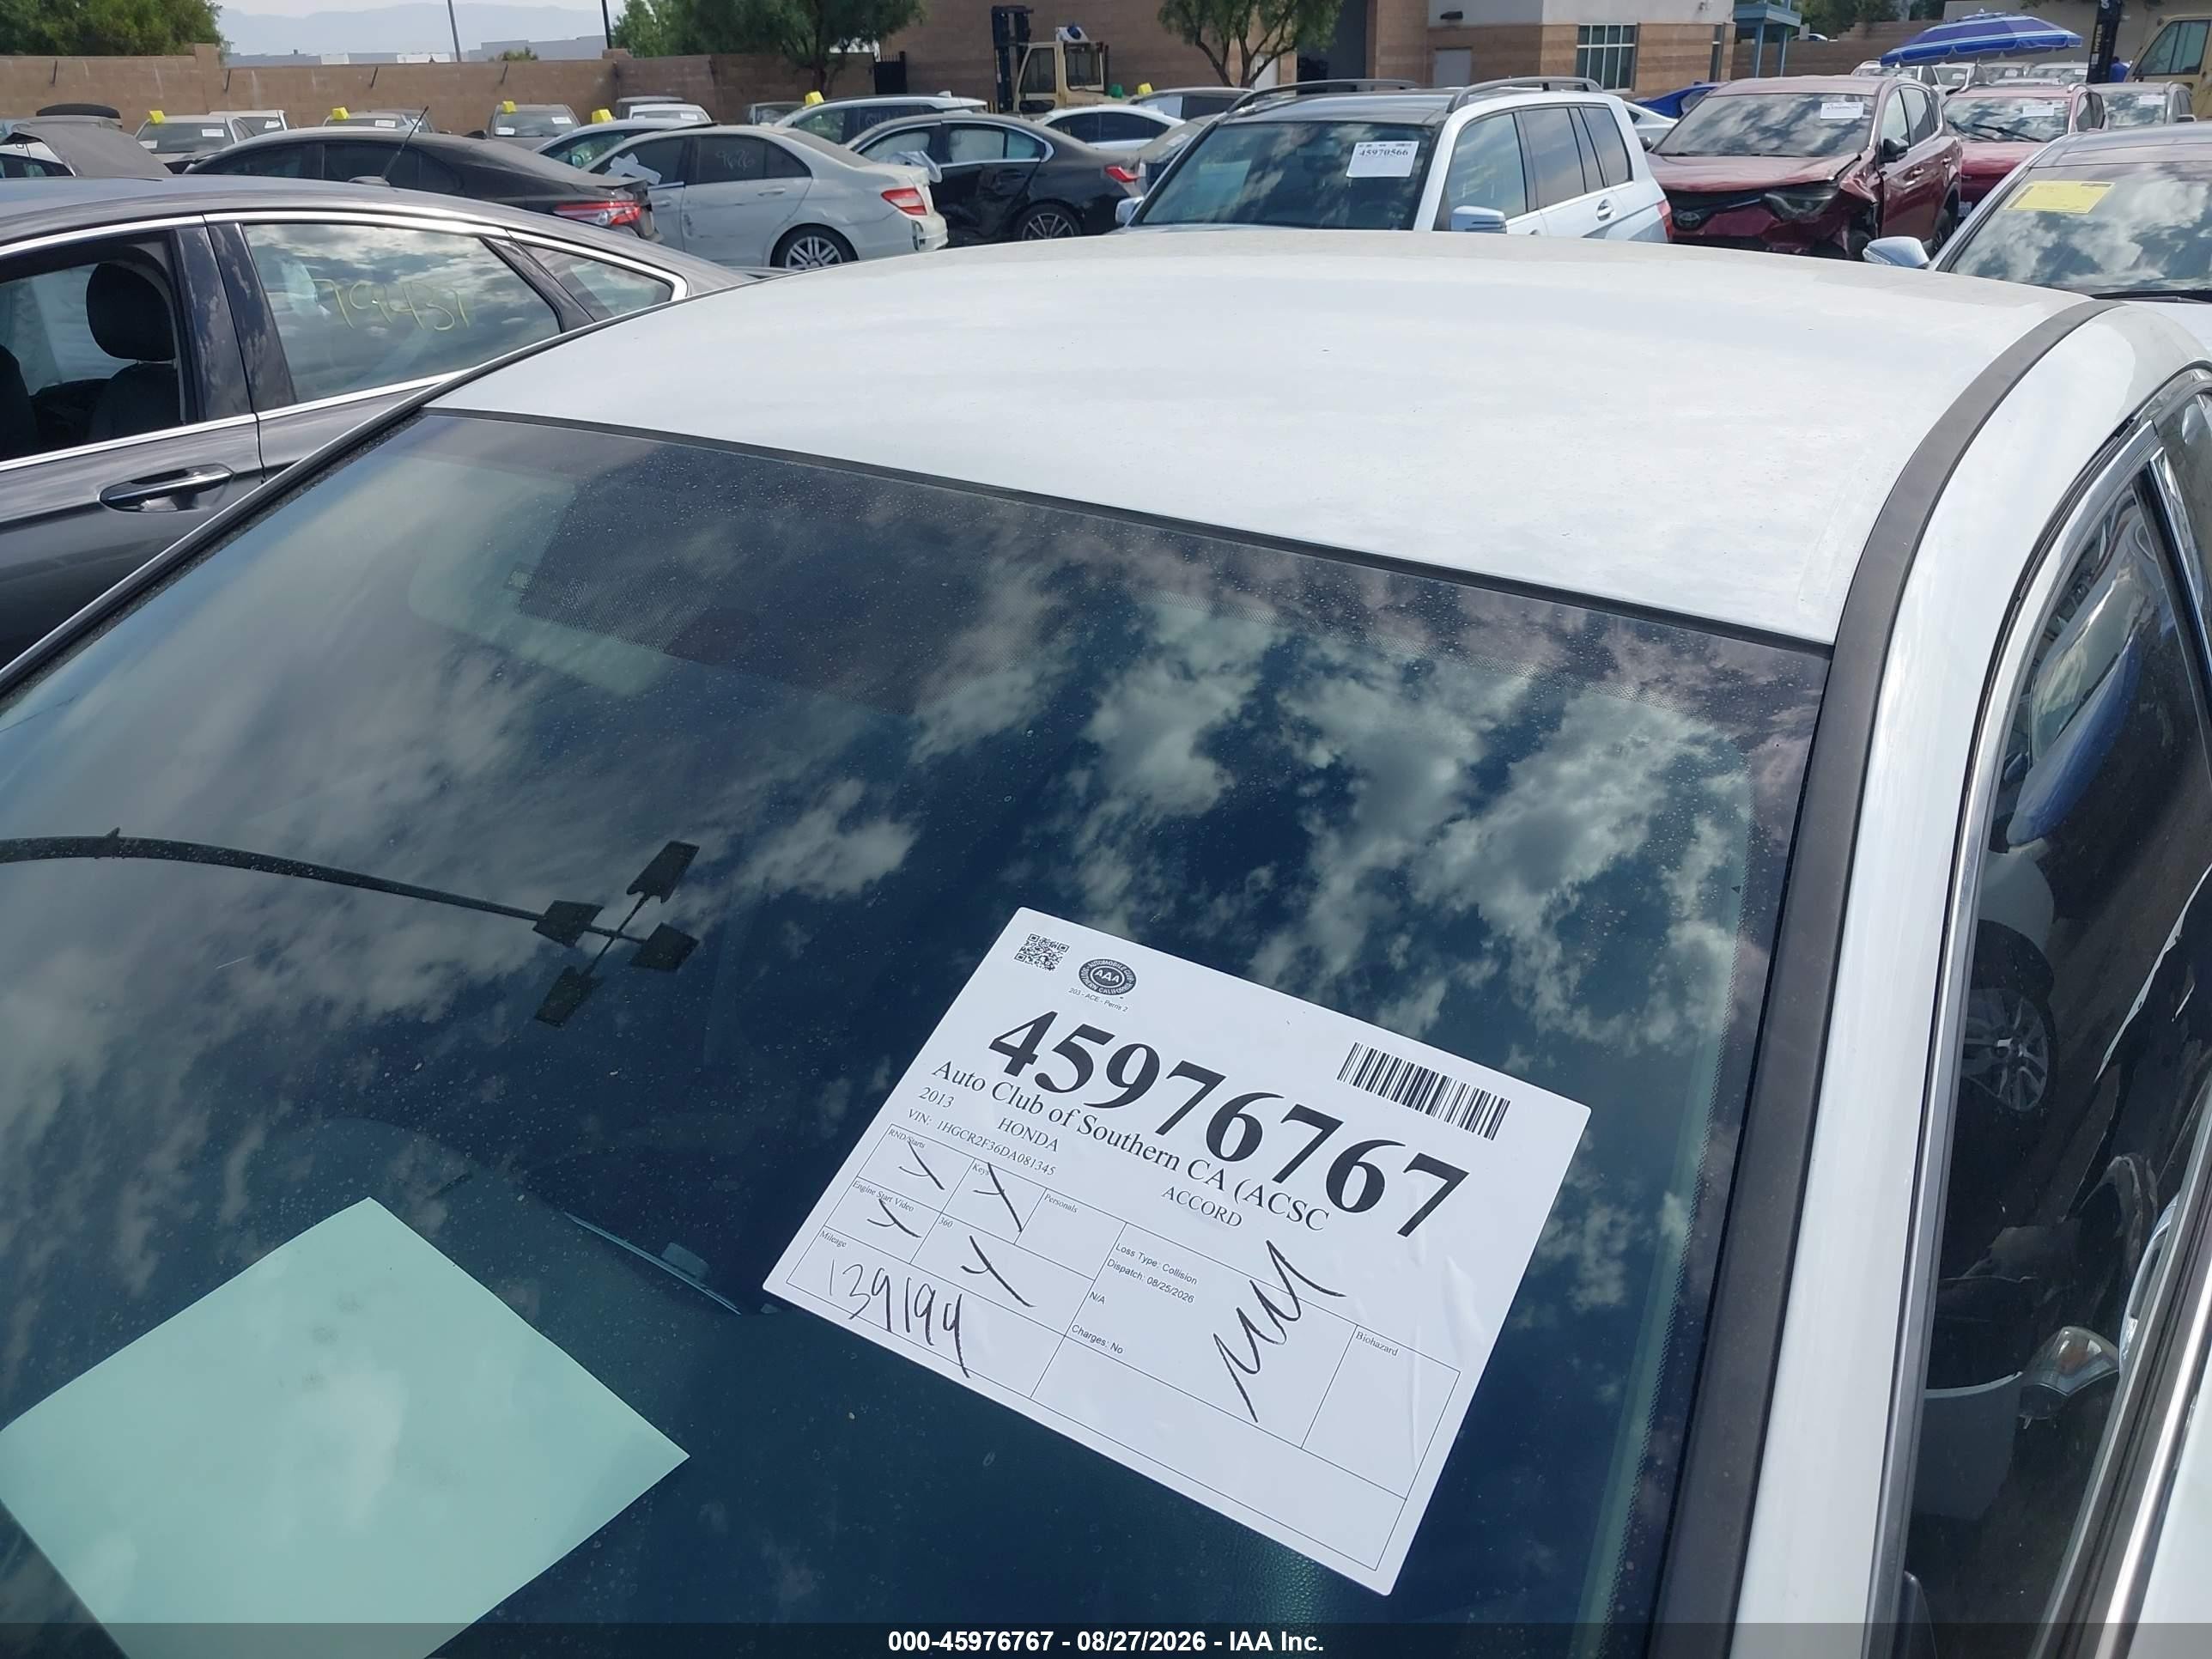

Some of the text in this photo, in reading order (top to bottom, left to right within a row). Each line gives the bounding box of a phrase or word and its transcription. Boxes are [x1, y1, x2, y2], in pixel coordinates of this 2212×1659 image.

[1094, 969, 1121, 983] AAA
[1068, 988, 1081, 996] 203
[1085, 993, 1101, 1002] ACE
[919, 1086, 955, 1109] 2013
[988, 1010, 1470, 1238] 45976767
[997, 1117, 1059, 1152] HONDA
[888, 1127, 926, 1149] RND/Starts
[908, 1109, 1057, 1176] VIN: 1HGCR2F36DA081345
[933, 1060, 1330, 1231] Auto Club of Southern CA (ACSC
[971, 1162, 990, 1176] Keys
[852, 1180, 915, 1212] Engine Start Video
[1043, 1193, 1079, 1213] Personals
[1161, 1185, 1243, 1228] ACCORD
[939, 1217, 953, 1229] 360
[819, 1230, 847, 1248] Mileage
[1115, 1243, 1198, 1285] Loss Type: Collision
[1107, 1258, 1195, 1304] Dispatch: 08/25/2026
[1089, 1291, 1106, 1305] N/A
[1072, 1324, 1124, 1354] Charges: No
[1356, 1331, 1399, 1356] Biohazard
